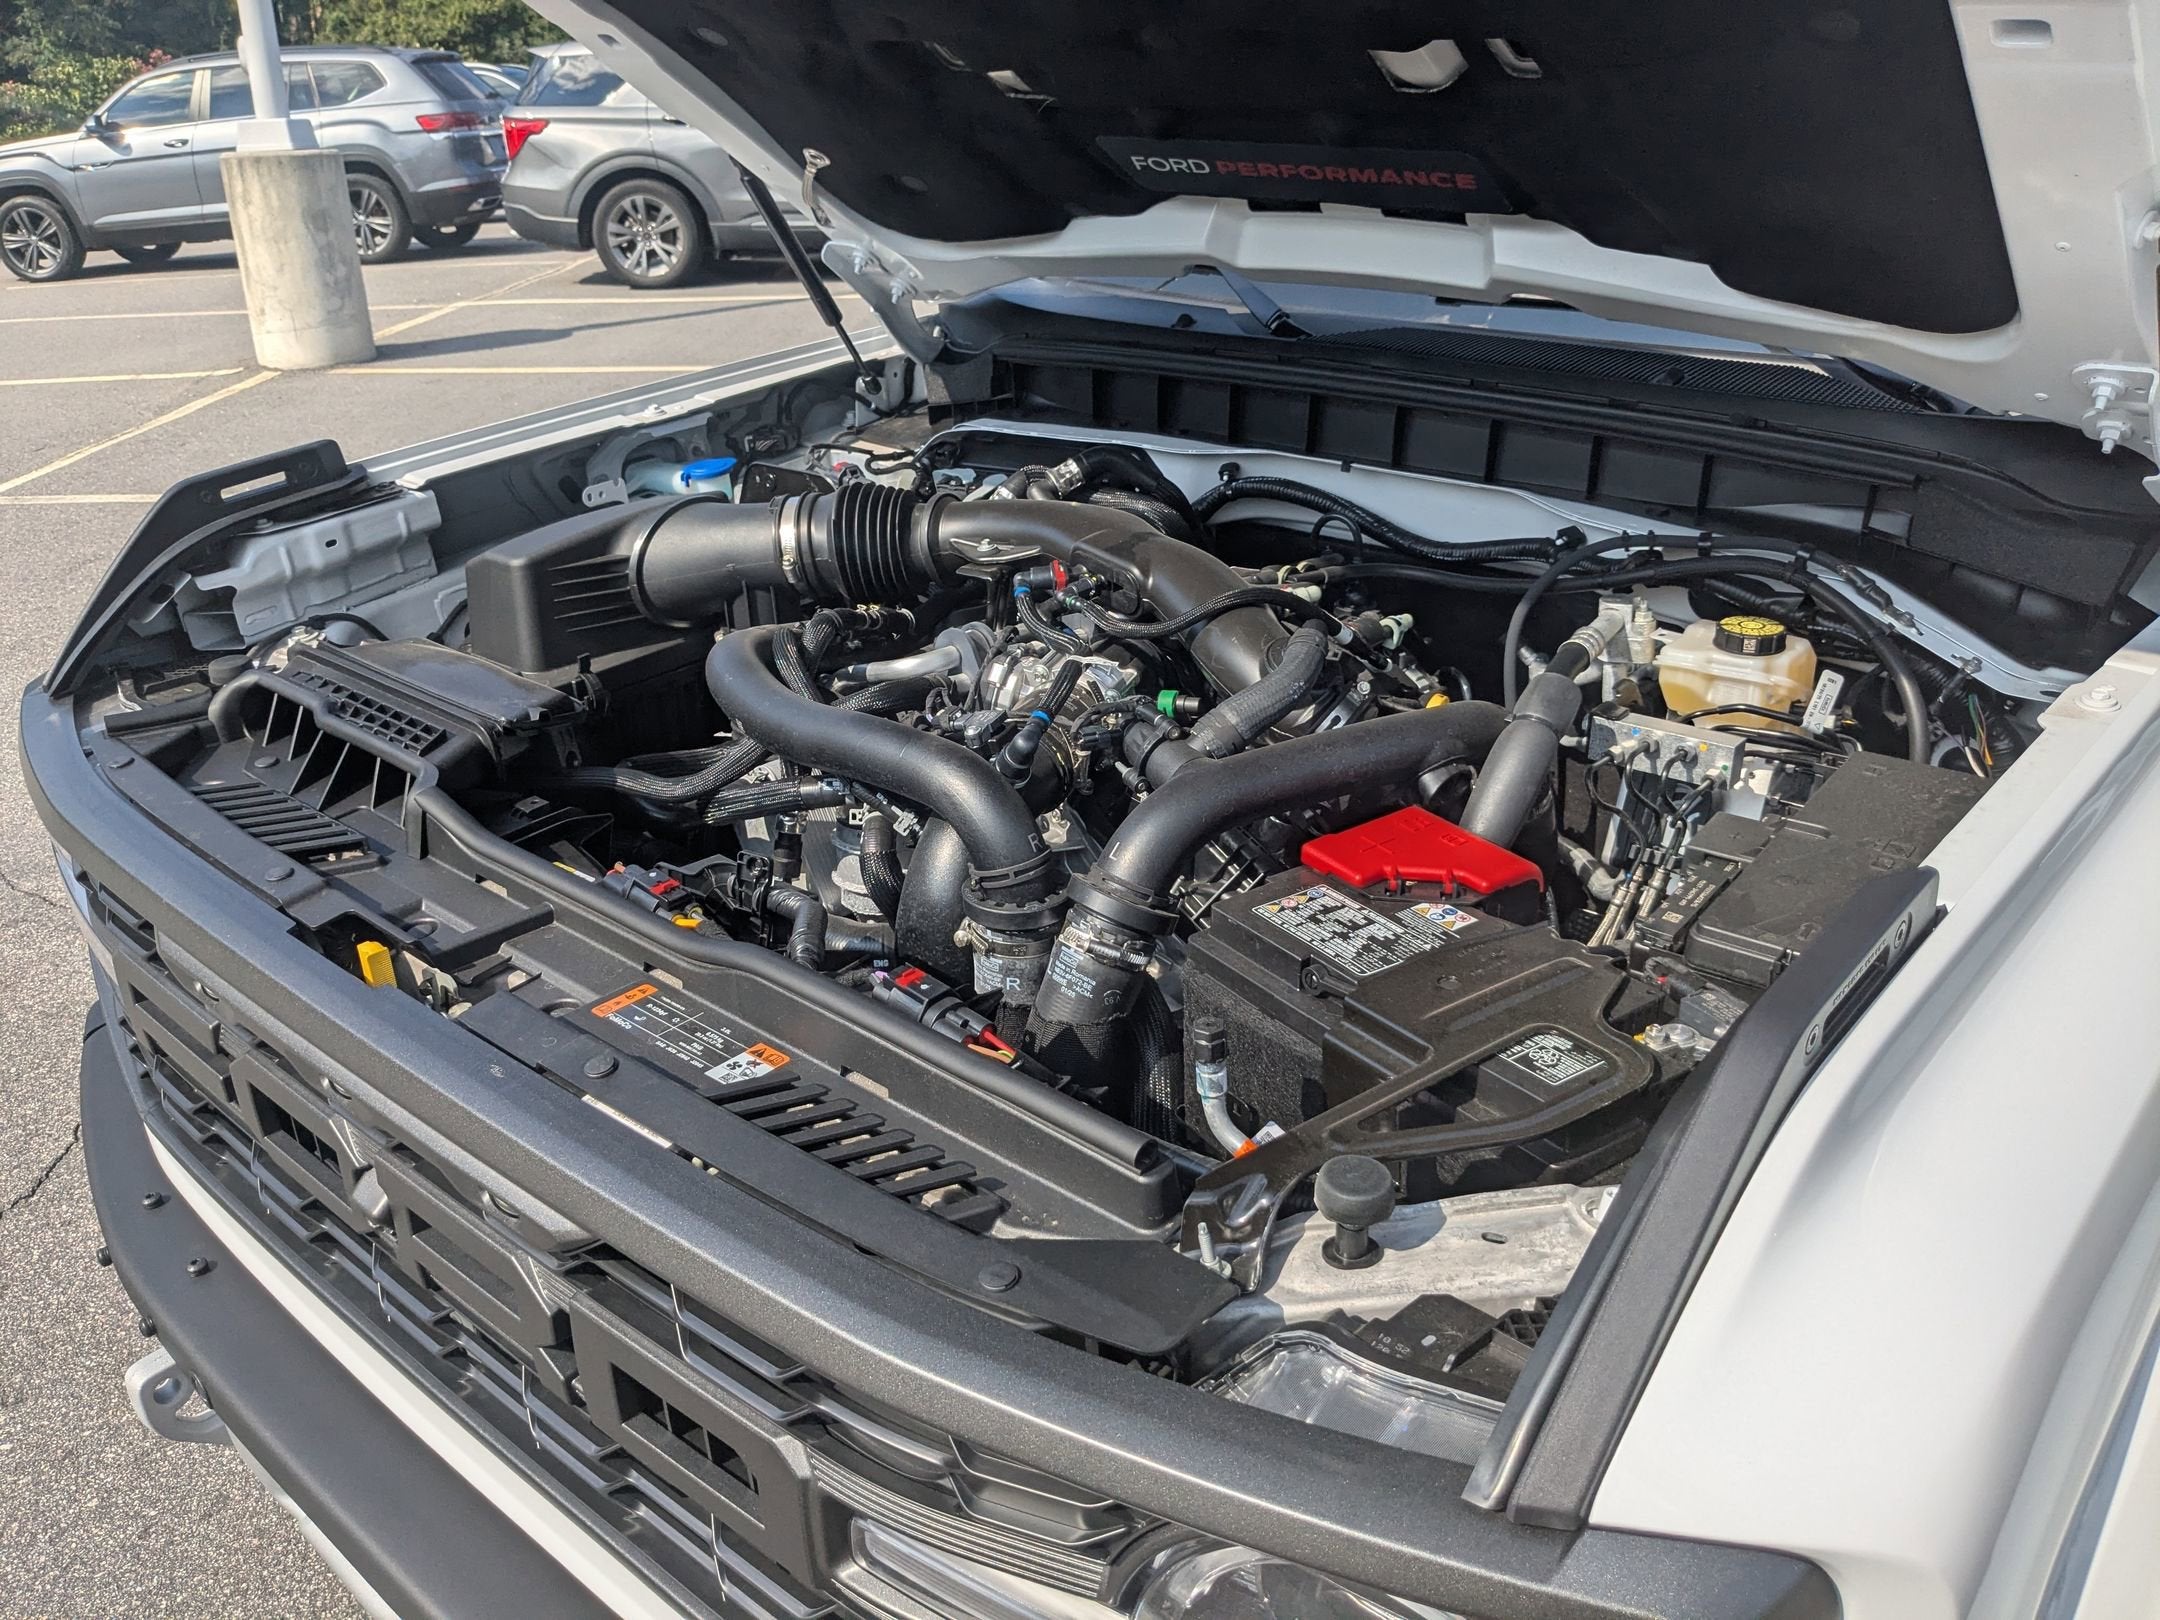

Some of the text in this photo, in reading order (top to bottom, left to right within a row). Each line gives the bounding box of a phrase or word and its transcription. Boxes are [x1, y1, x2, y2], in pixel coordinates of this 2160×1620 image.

[1130, 156, 1478, 189] FORD PERFORMANCE
[1006, 977, 1021, 991] R
[606, 1013, 632, 1029] FoMoCo
